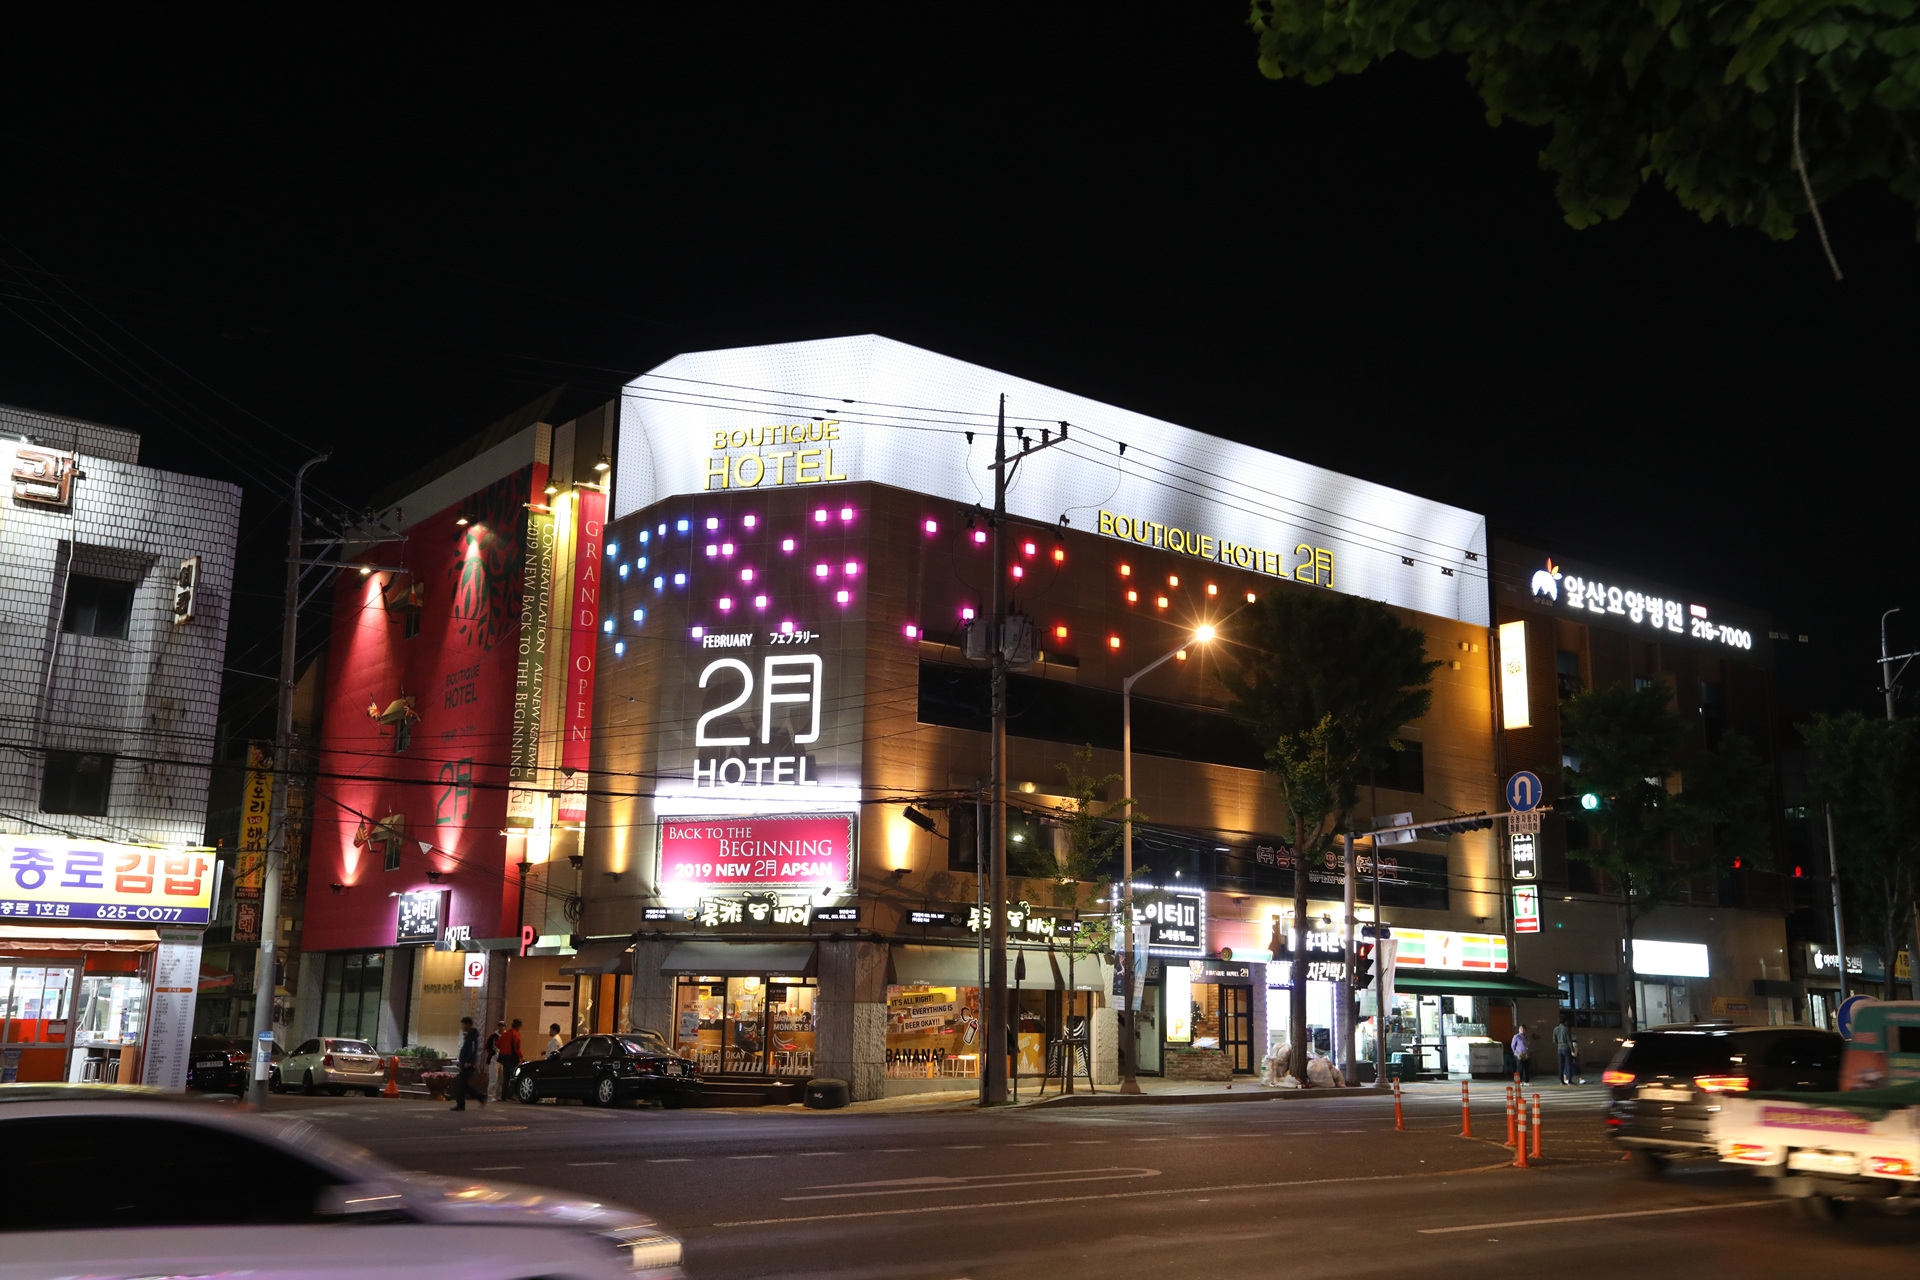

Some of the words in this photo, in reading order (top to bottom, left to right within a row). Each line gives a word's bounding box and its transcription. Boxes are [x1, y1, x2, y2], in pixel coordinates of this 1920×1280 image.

[712, 420, 840, 449] BOUTIQUE
[703, 448, 847, 490] HOTEL
[526, 518, 540, 549] 2019
[1098, 510, 1215, 560] BOUTIQUE
[1219, 540, 1289, 577] HOTEL
[524, 553, 537, 591] NEW
[580, 520, 600, 627] GRAND
[535, 522, 555, 654] CONGRATULATION
[520, 594, 536, 632] BACK
[1563, 575, 1684, 633] 앞산요양병원
[518, 634, 532, 655] TO
[702, 633, 753, 648] FEBRUARY
[446, 663, 481, 688] BOUTIQUE
[515, 658, 530, 690] THE
[533, 662, 544, 690] ALL
[444, 683, 479, 710] HOTEL
[530, 691, 543, 721] NEW
[571, 655, 591, 742] OPEN
[695, 653, 823, 747] 2月
[509, 692, 528, 778] BEGINNING
[526, 723, 540, 777] RENEWAL
[693, 756, 818, 788] HOTEL
[669, 827, 702, 839] BACK
[705, 827, 724, 838] TO
[727, 827, 752, 838] THE
[719, 840, 833, 857] BEGINNING
[10, 847, 105, 890] 종로
[115, 853, 208, 897] 김밥
[674, 863, 712, 877] 2019
[715, 863, 751, 877] NEW
[780, 862, 833, 876] APSAN
[1, 902, 30, 915] 종로
[35, 903, 70, 917] 1호점
[96, 905, 182, 921] 625-0077
[239, 904, 256, 932] 노래
[773, 904, 812, 926] 비어
[444, 926, 471, 941] HOTEL
[520, 925, 534, 958] P
[472, 963, 482, 975] P
[892, 998, 903, 1007] IT'S
[903, 997, 915, 1006] ALL
[915, 995, 934, 1004] RIGHT!
[912, 1005, 946, 1016] EVERYTHING
[773, 1023, 803, 1031] MONKEY
[905, 1020, 920, 1030] BEER
[921, 1019, 940, 1028] OKAY!!
[886, 1047, 945, 1063] BANANA?
